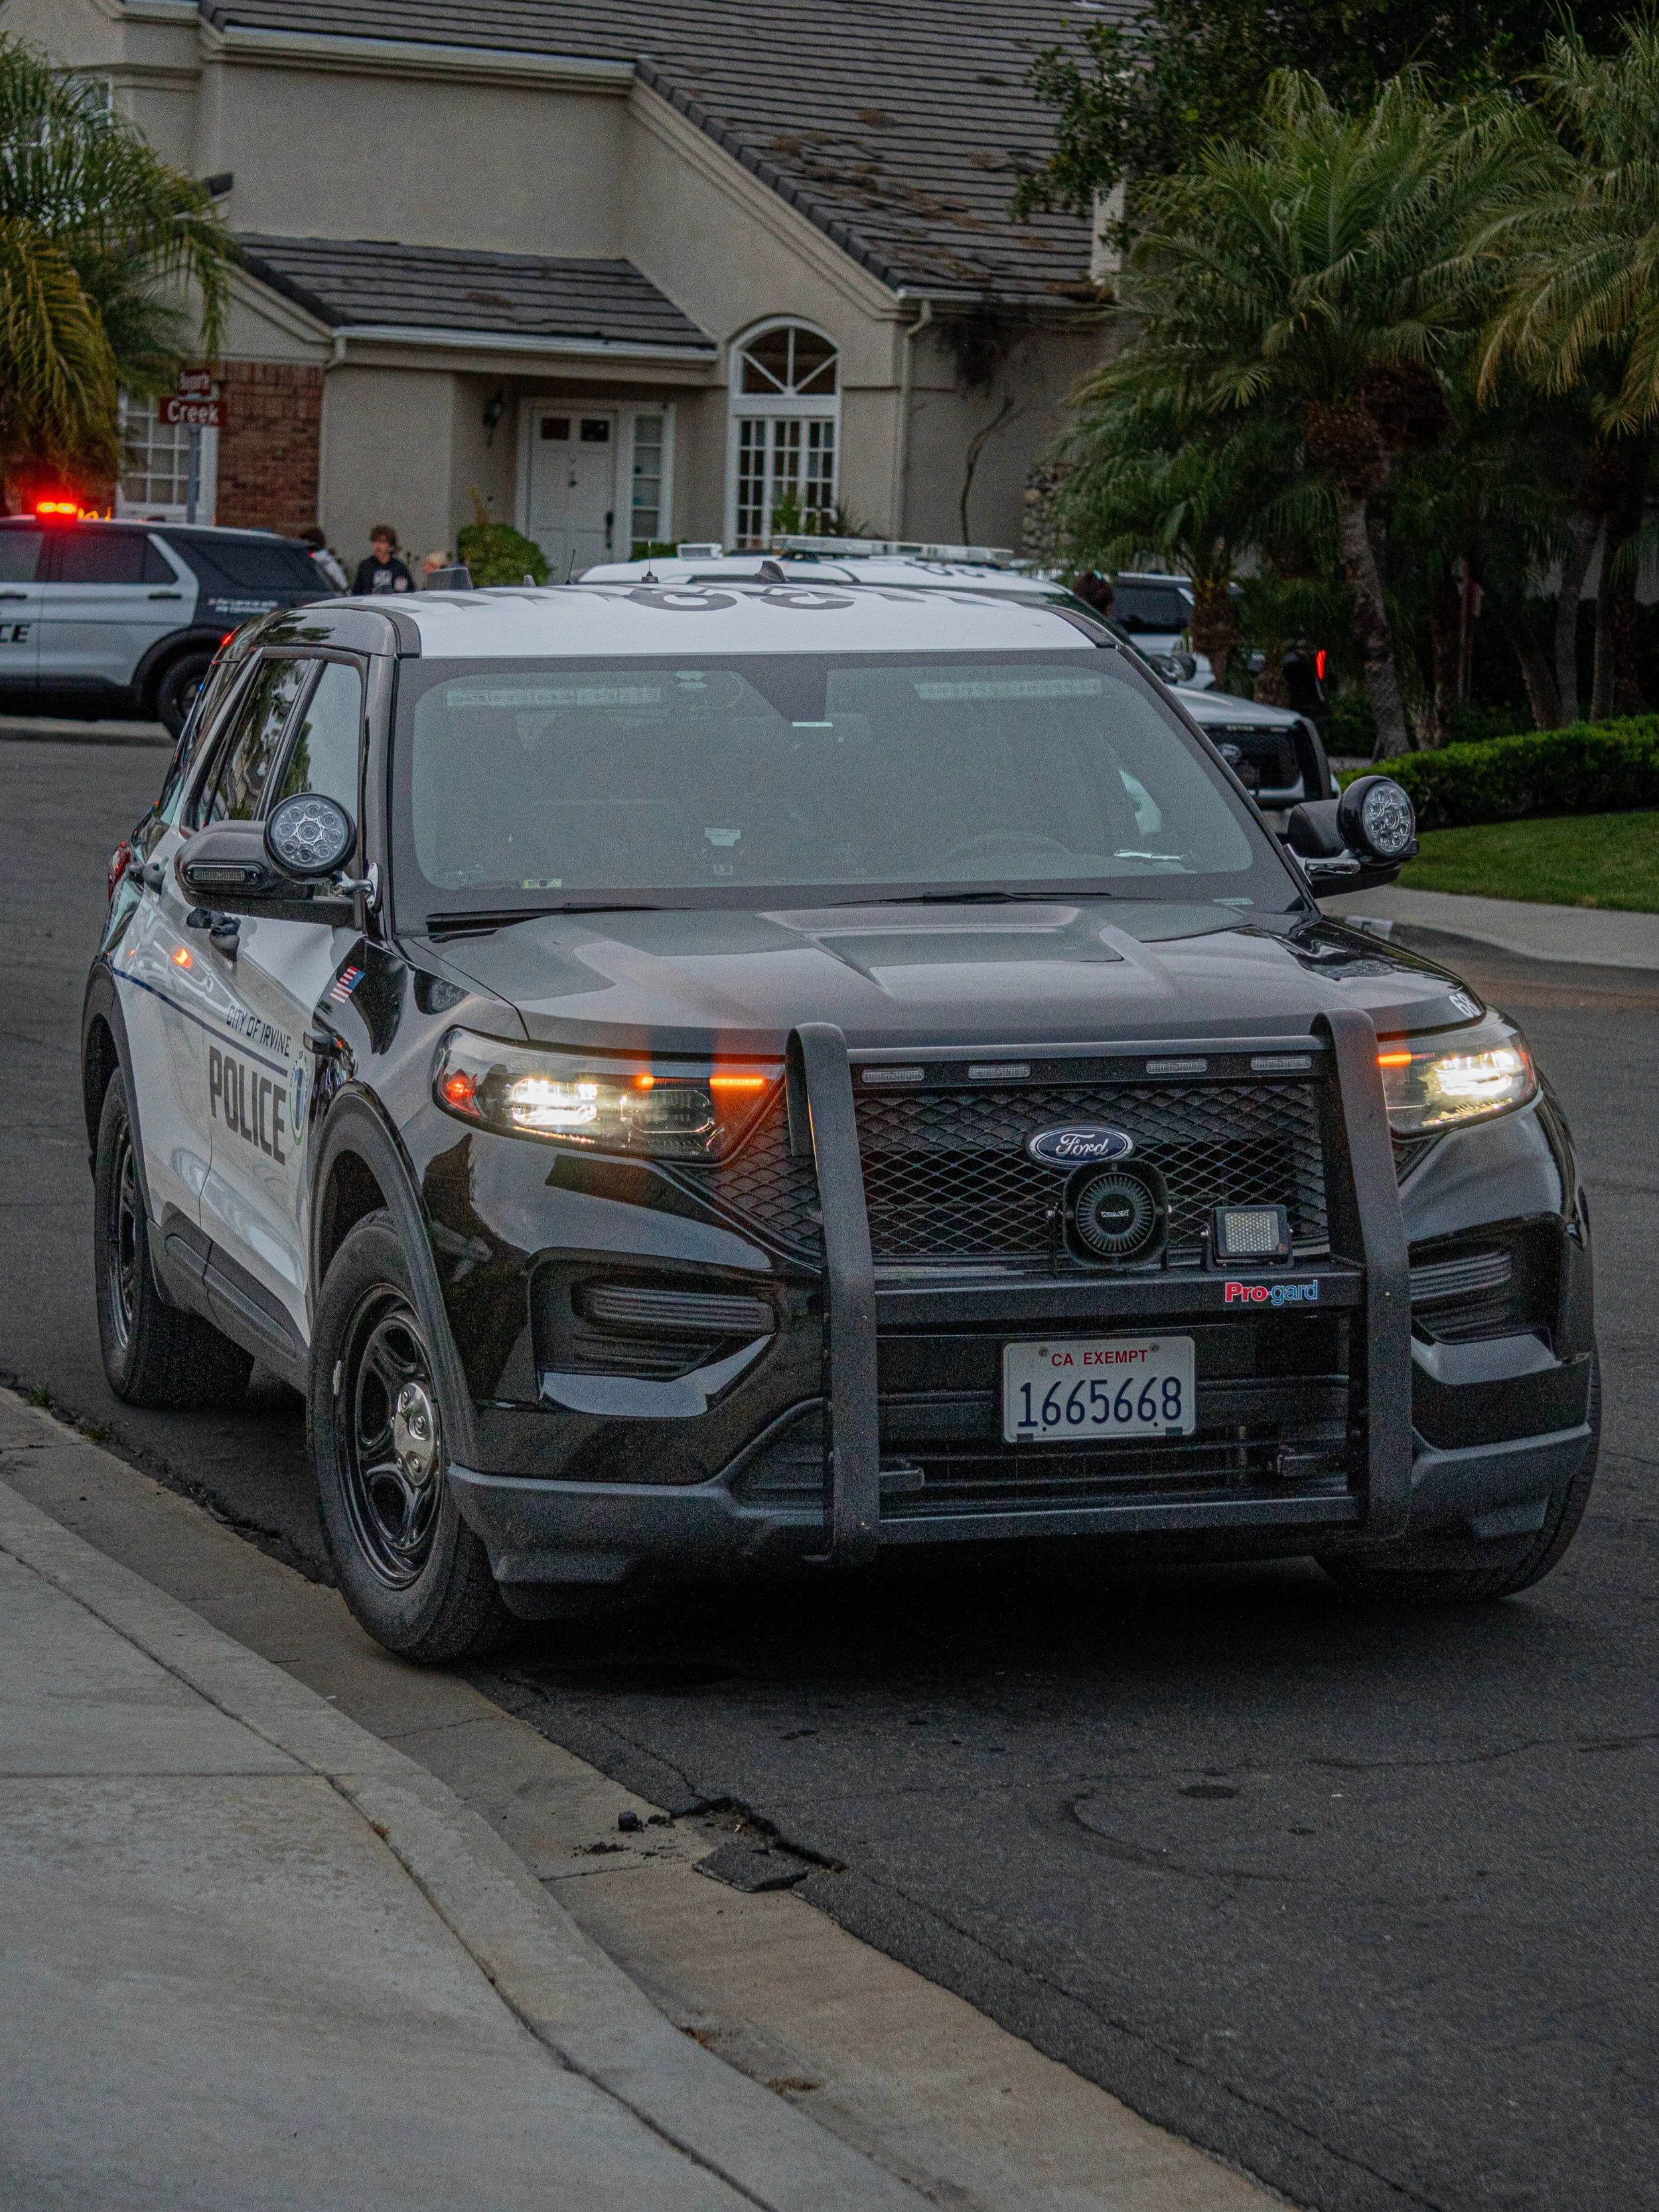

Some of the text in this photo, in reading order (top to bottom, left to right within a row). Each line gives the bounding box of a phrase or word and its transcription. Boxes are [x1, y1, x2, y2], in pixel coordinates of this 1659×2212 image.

[168, 400, 219, 424] Creek
[1449, 993, 1481, 1018] 68
[226, 1005, 292, 1058] CITY OF IRVINE
[209, 1045, 287, 1166] POLICE
[1055, 1134, 1109, 1156] Ford
[1225, 1279, 1318, 1306] Pro-gard
[1051, 1349, 1148, 1366] CA EXEMPT
[1018, 1376, 1181, 1427] 1665668
